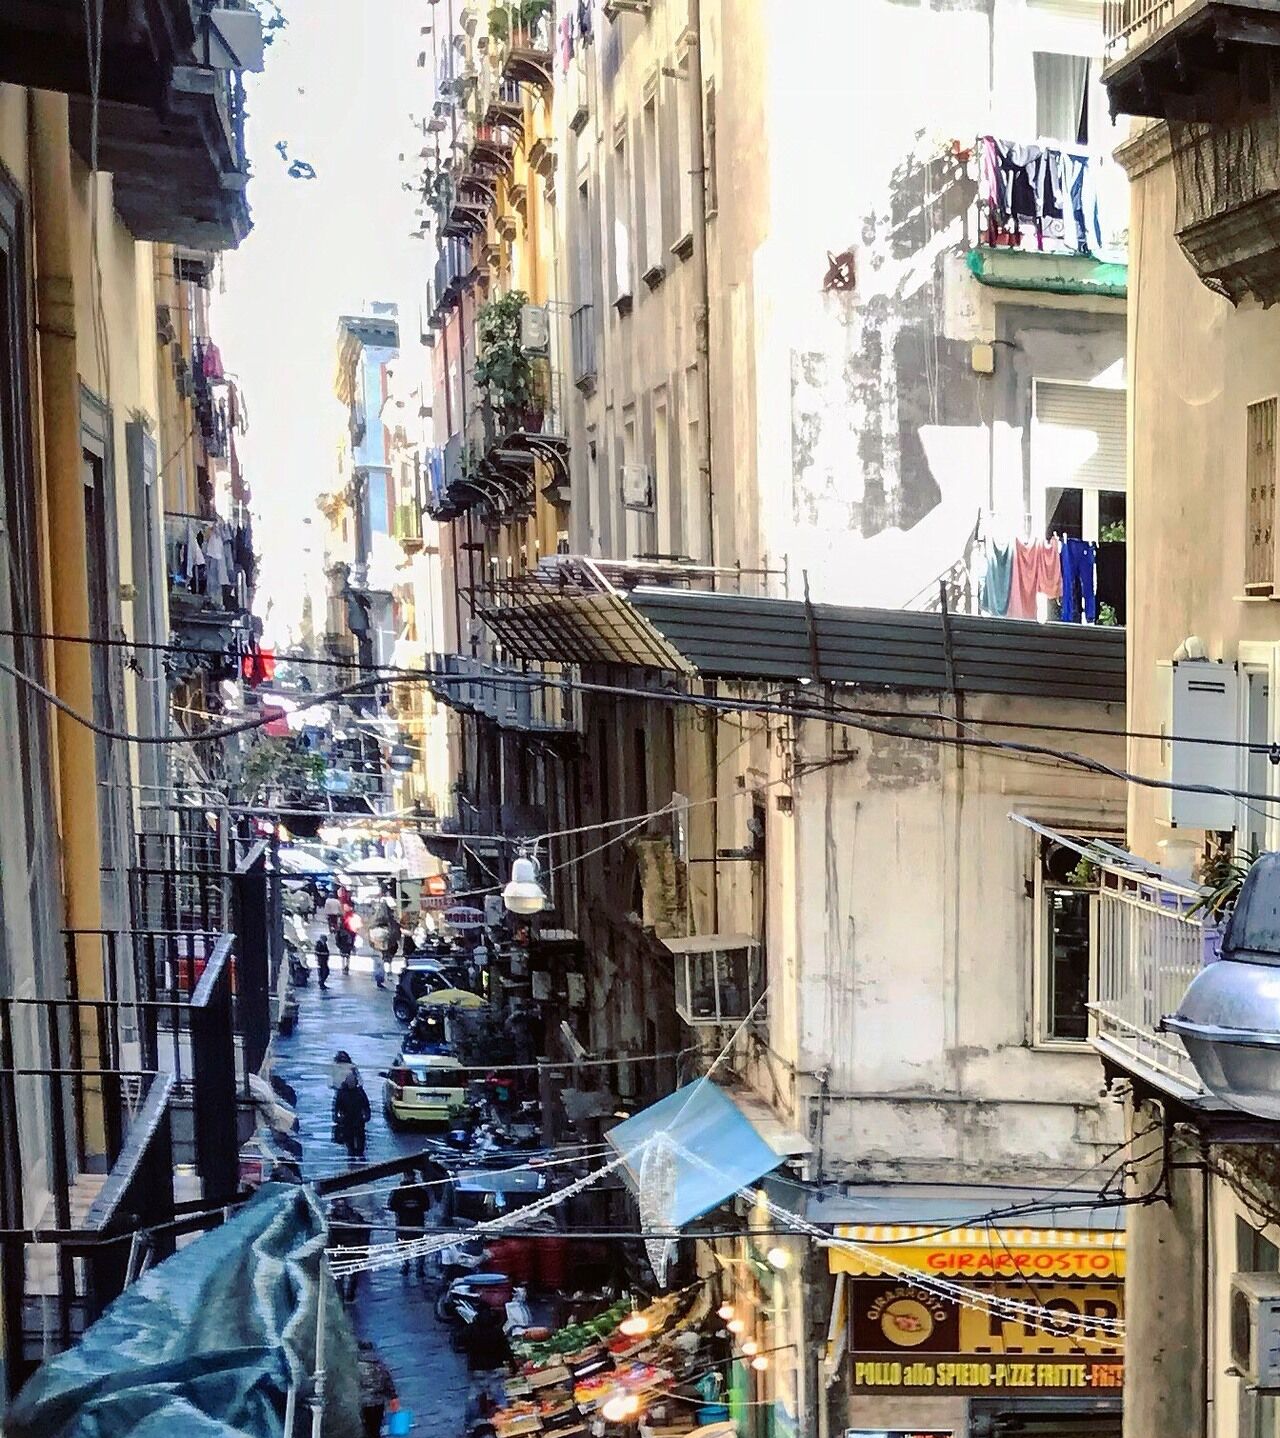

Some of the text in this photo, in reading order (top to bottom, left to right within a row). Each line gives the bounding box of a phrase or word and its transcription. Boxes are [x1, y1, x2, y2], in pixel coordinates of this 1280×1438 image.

[927, 1252, 1110, 1271] GIRARROSTO
[855, 1362, 901, 1386] POLLO
[903, 1363, 935, 1386] allo
